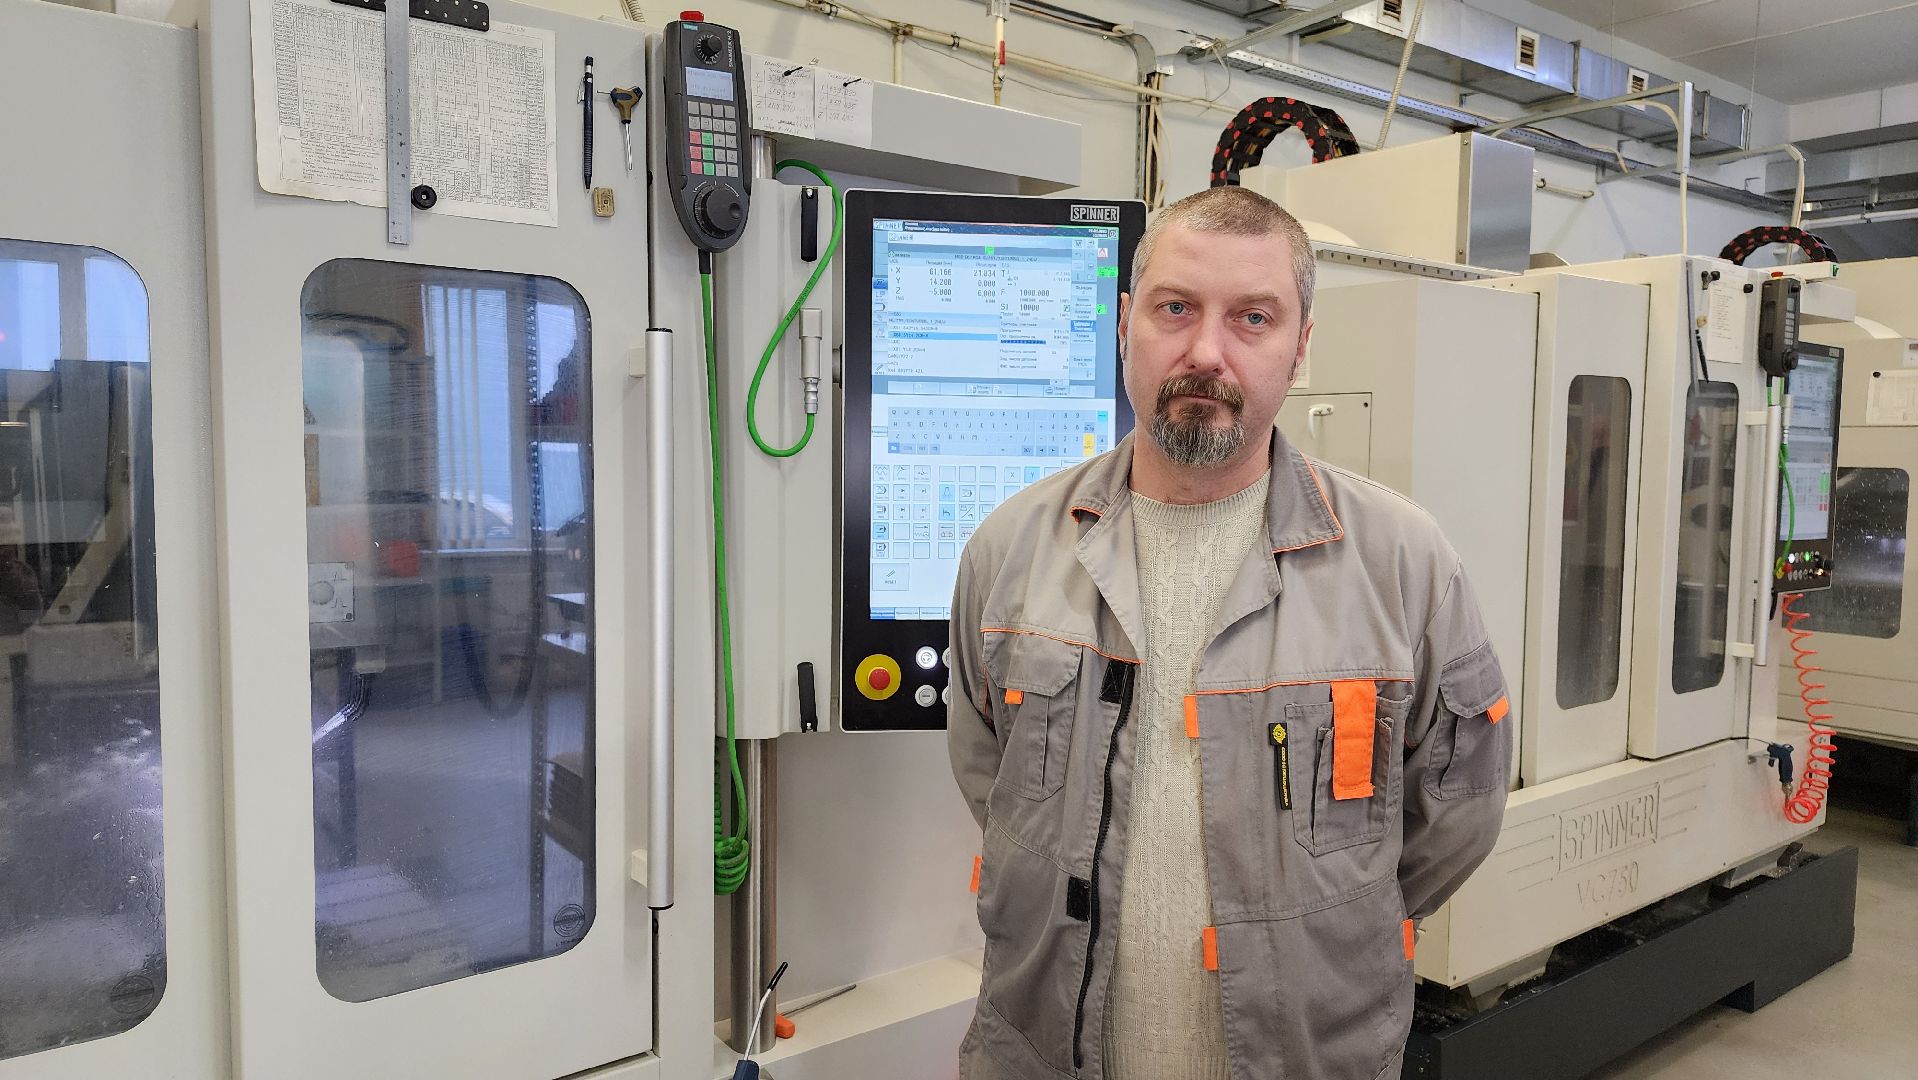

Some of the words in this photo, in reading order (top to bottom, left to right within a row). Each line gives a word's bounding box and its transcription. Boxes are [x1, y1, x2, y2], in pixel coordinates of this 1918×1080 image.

[1073, 207, 1117, 221] SPINNER
[1565, 794, 1654, 862] SPINNER
[1578, 861, 1639, 904] VC750
